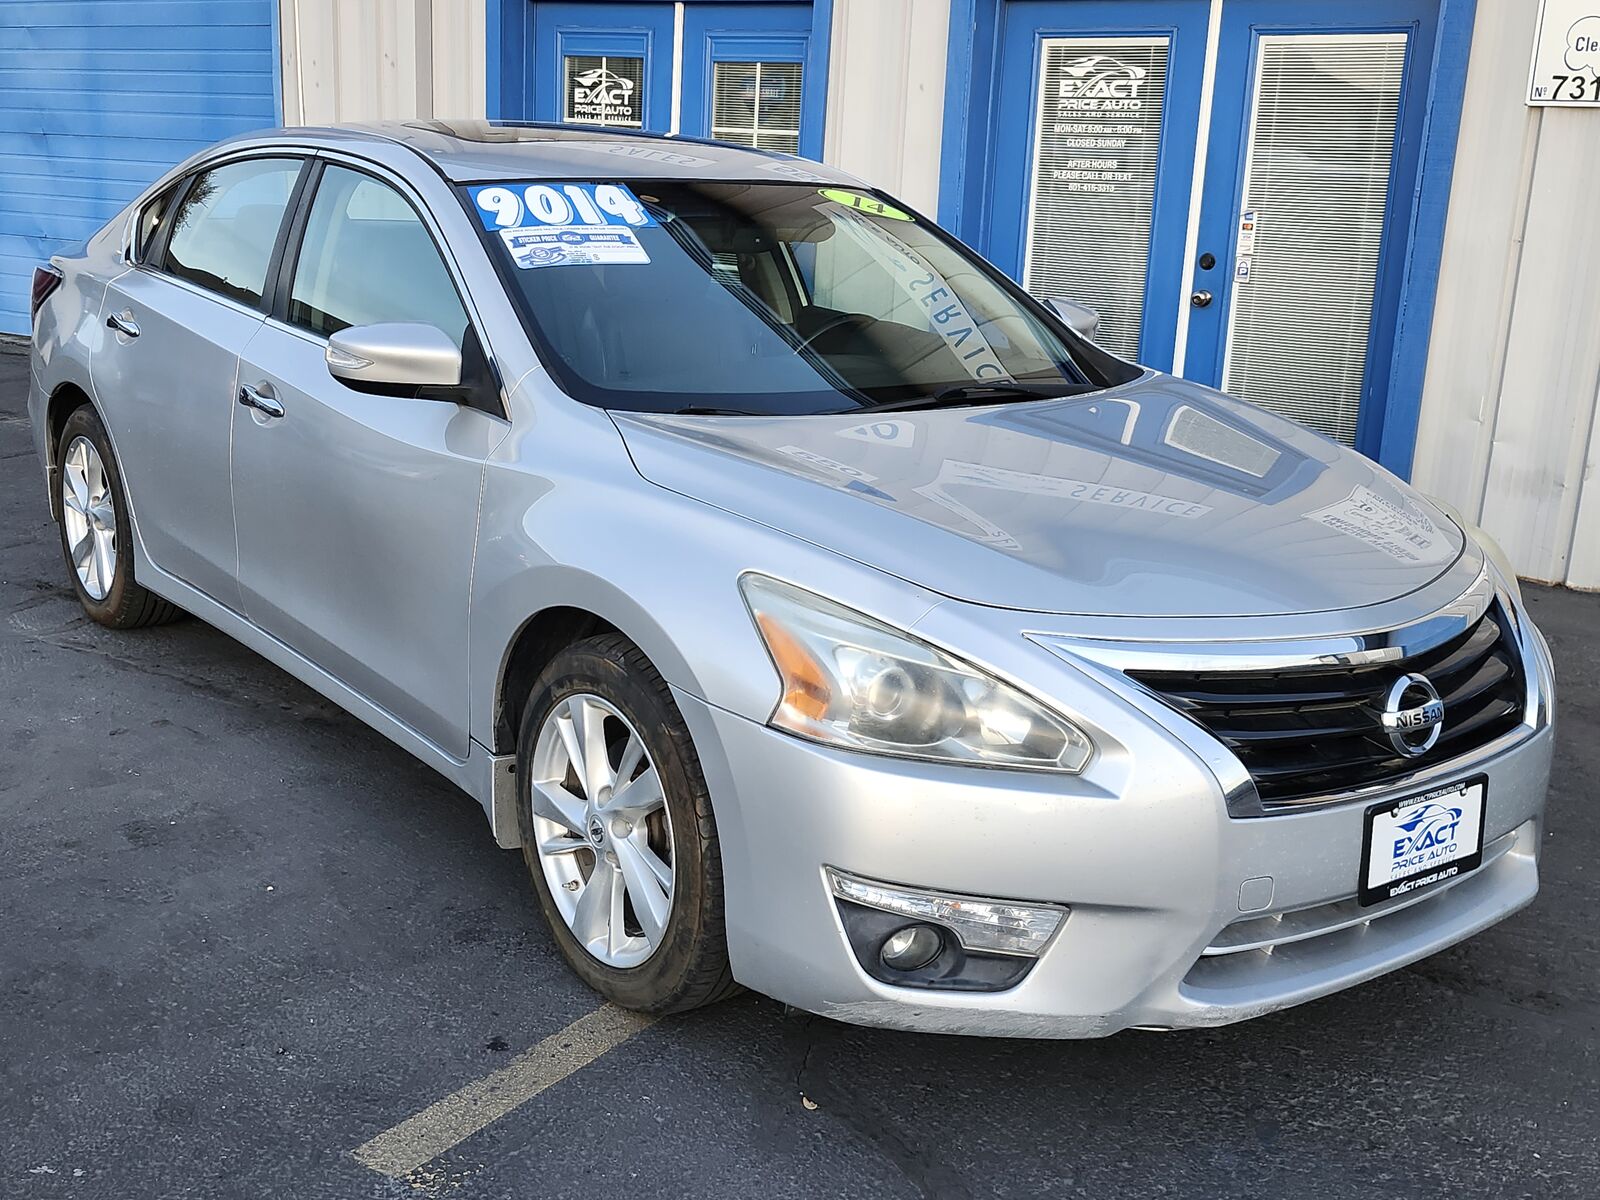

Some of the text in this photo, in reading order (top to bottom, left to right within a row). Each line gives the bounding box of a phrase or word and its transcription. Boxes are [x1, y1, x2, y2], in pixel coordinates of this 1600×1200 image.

[1575, 36, 1600, 52] Cle
[574, 87, 633, 105] EXACT
[1059, 80, 1145, 97] EXACT
[574, 104, 632, 115] PRICE AUTO
[1058, 99, 1141, 110] PRICE AUTO
[1067, 138, 1126, 148] CLOSED SUNDAY
[1067, 160, 1117, 169] AFTER HOURS
[1053, 170, 1080, 179] PLEASE
[853, 196, 887, 214] 14
[1396, 706, 1442, 729] NISSAN
[1392, 820, 1460, 859] EXACT
[1391, 843, 1458, 873] PRICE AUTO
[1389, 866, 1458, 897] EXACT PRICE AUTO
